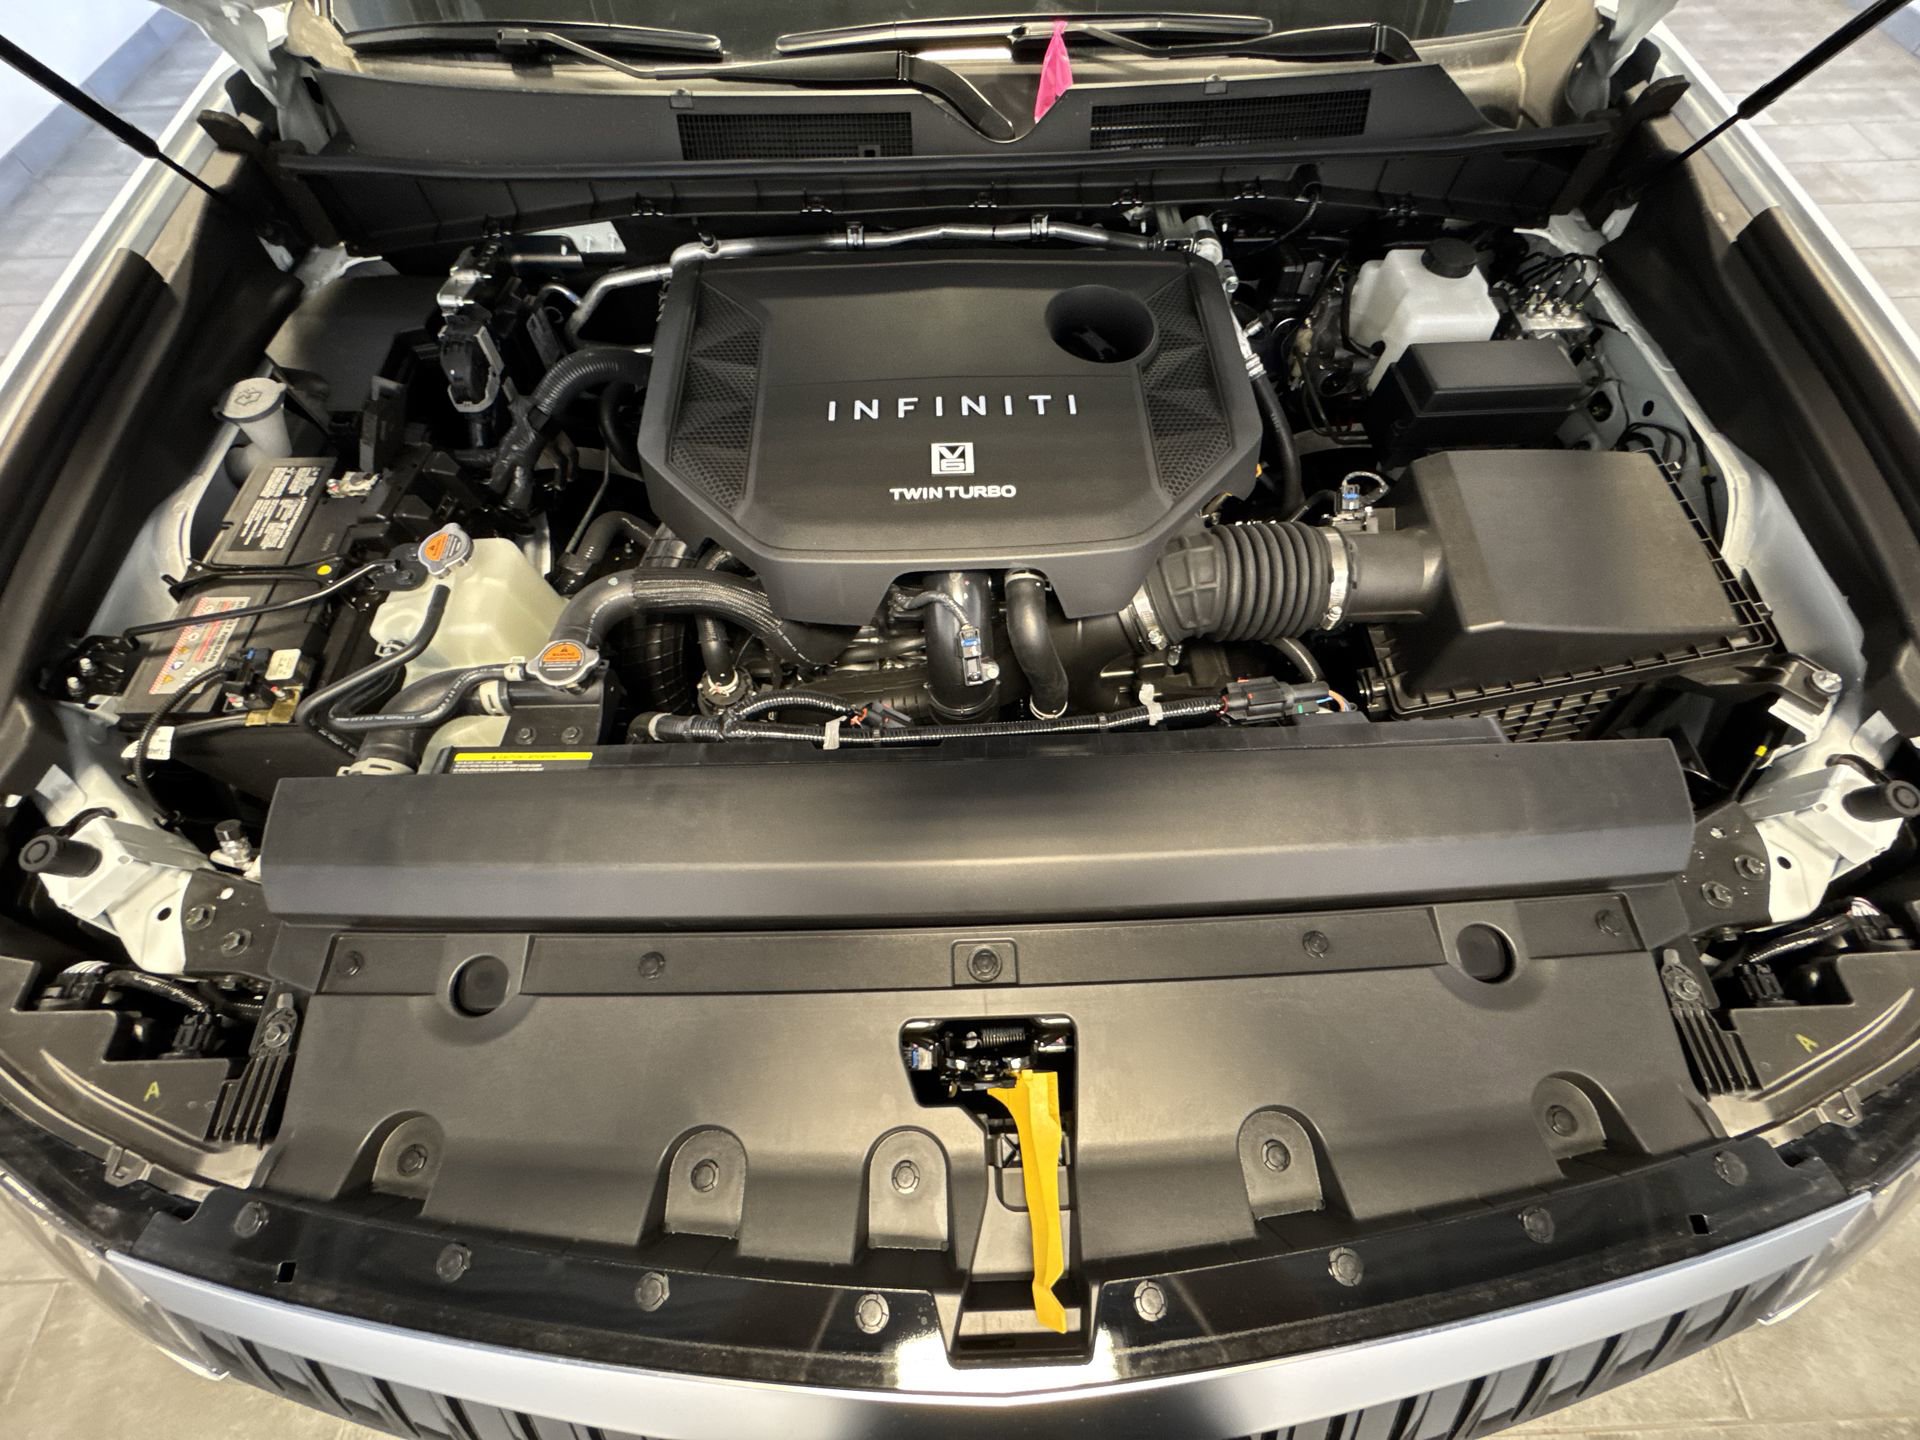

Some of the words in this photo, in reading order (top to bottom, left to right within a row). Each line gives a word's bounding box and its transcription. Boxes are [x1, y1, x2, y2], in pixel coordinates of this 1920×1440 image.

[828, 394, 1077, 421] INFINITI
[889, 487, 943, 501] TWIN
[945, 484, 1017, 499] TURBO
[1795, 1033, 1819, 1053] A
[143, 1080, 160, 1102] A
